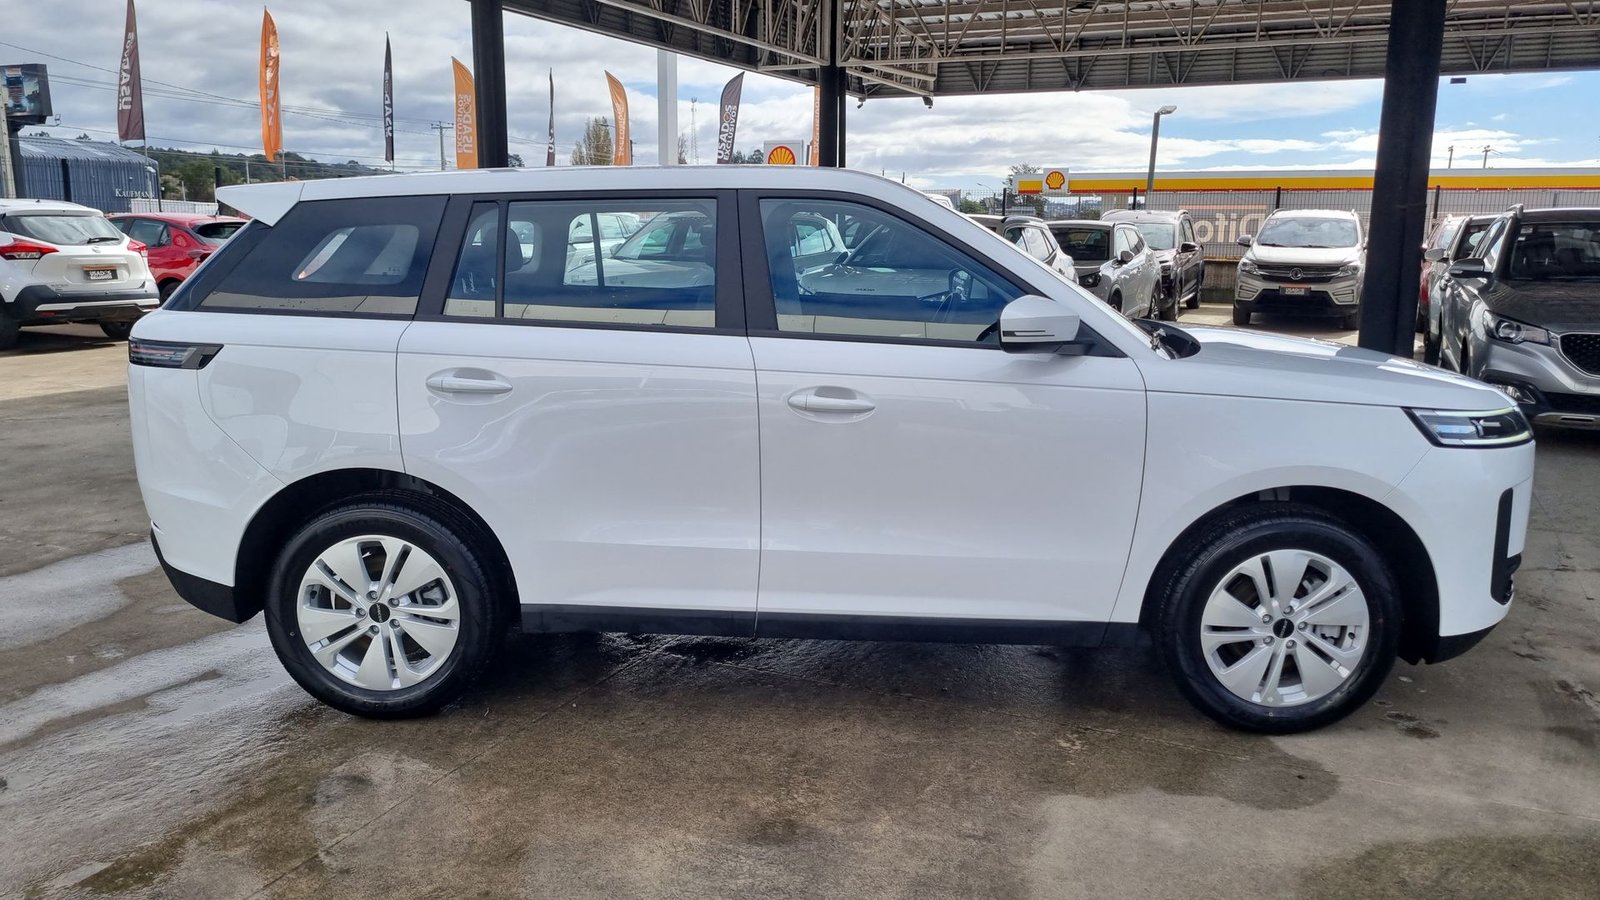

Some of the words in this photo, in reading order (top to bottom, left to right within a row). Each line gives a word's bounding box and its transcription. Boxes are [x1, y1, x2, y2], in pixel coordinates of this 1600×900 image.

[717, 104, 731, 160] USADOS
[723, 105, 737, 161] EXCLUSIVOS
[115, 188, 155, 198] KAUFMAN
